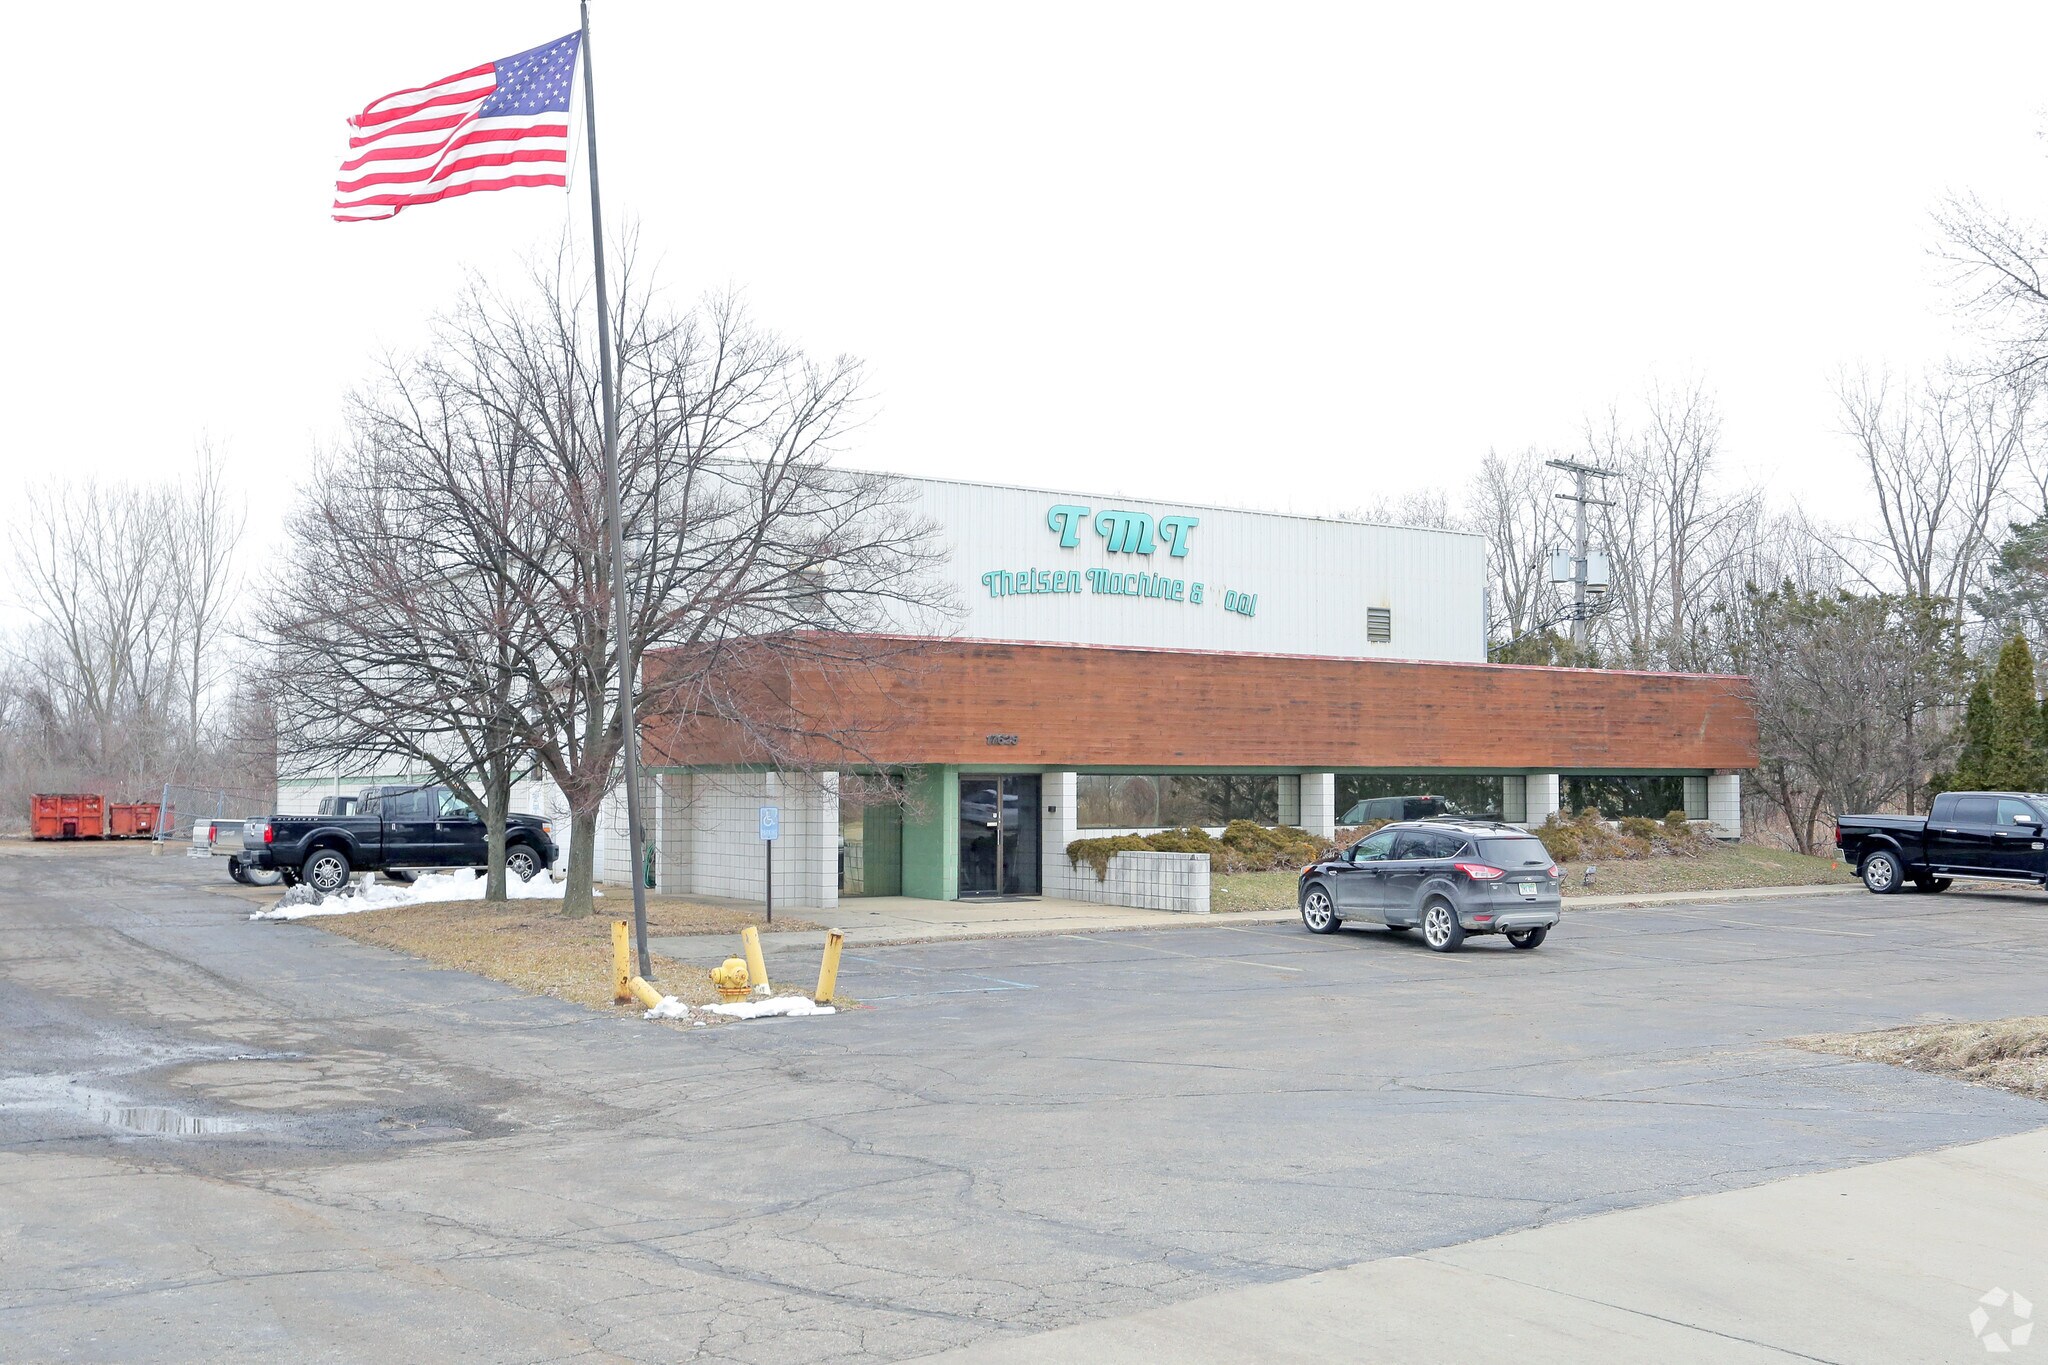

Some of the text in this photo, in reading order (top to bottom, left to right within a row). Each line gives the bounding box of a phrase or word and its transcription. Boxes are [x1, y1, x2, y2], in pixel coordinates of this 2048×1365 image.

[1047, 504, 1200, 557] TMT
[982, 567, 1083, 598] Theisen
[1086, 568, 1184, 601] Machine
[1190, 582, 1204, 604] &
